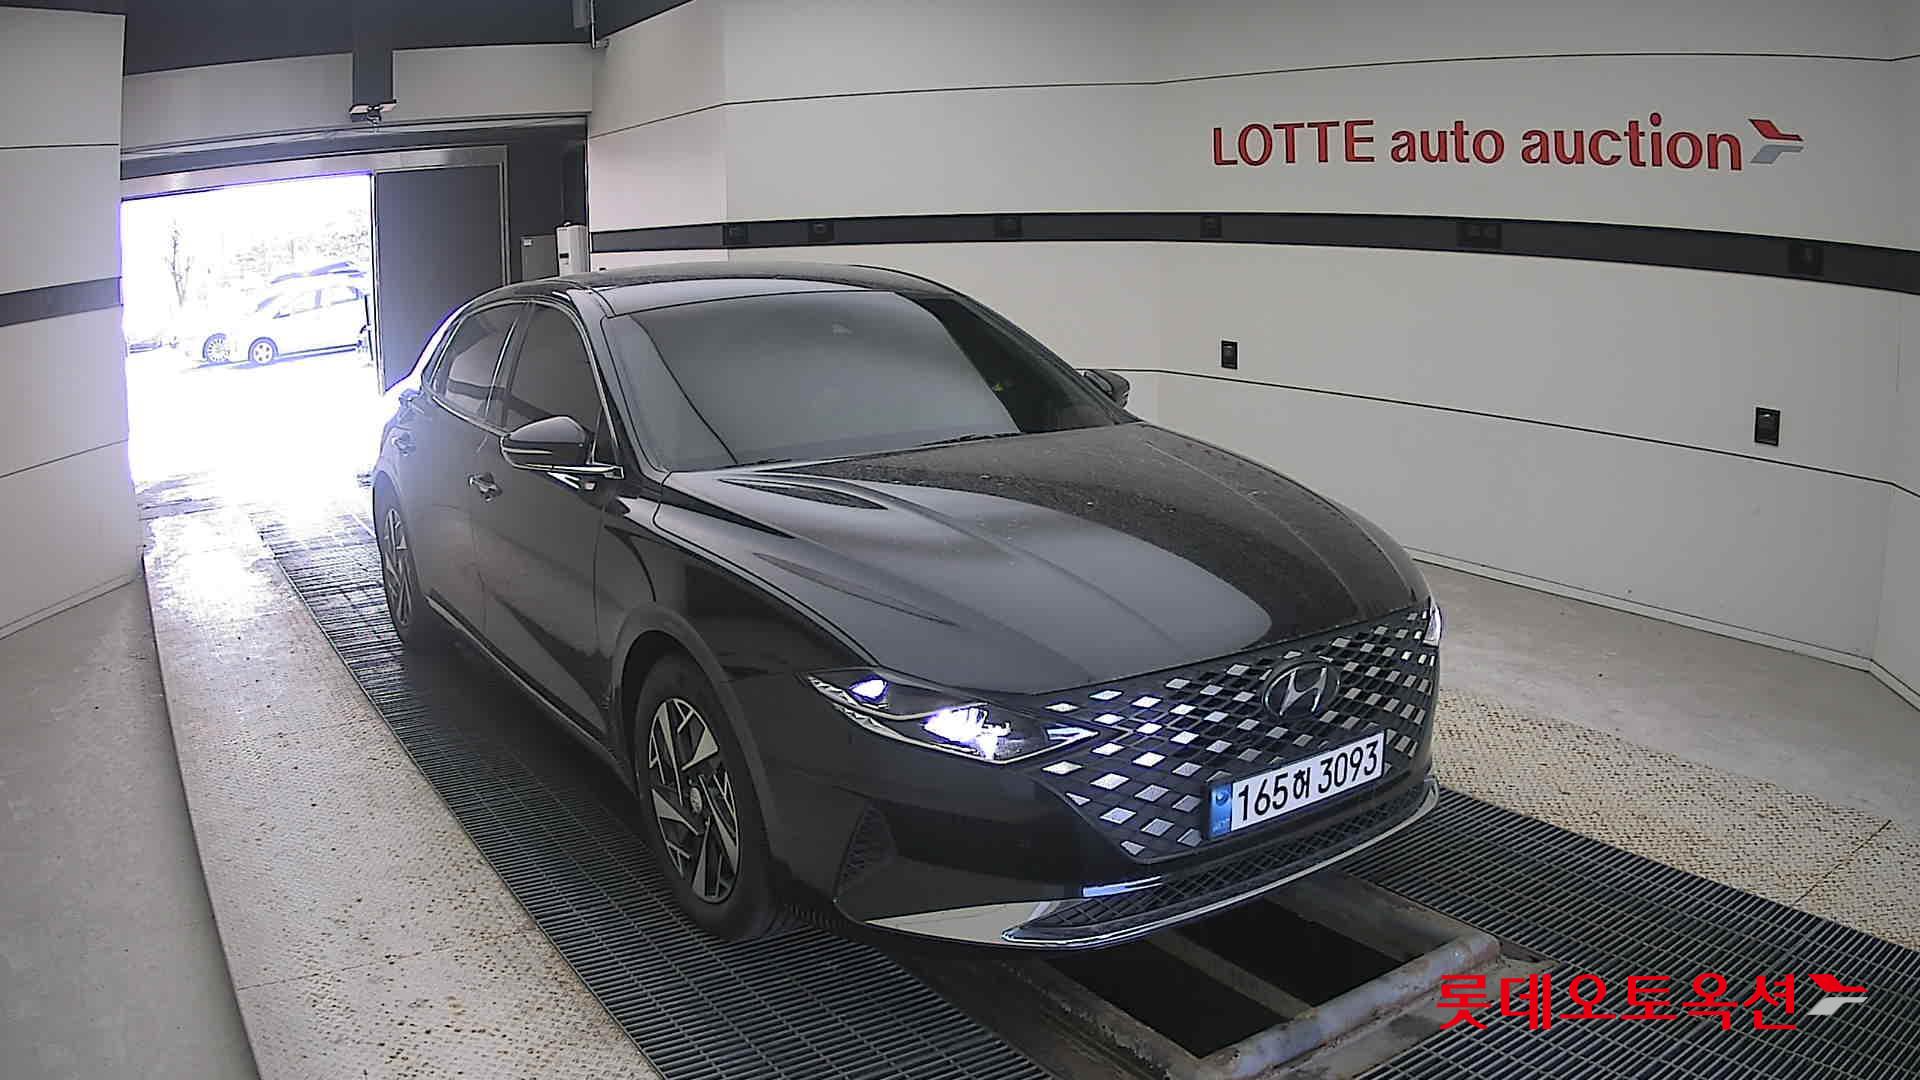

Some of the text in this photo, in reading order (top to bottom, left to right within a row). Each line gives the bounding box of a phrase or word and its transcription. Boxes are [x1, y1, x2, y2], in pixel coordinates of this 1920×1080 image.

[1213, 112, 1743, 171] LOTTE auto auction
[1238, 740, 1379, 821] 165허 3093
